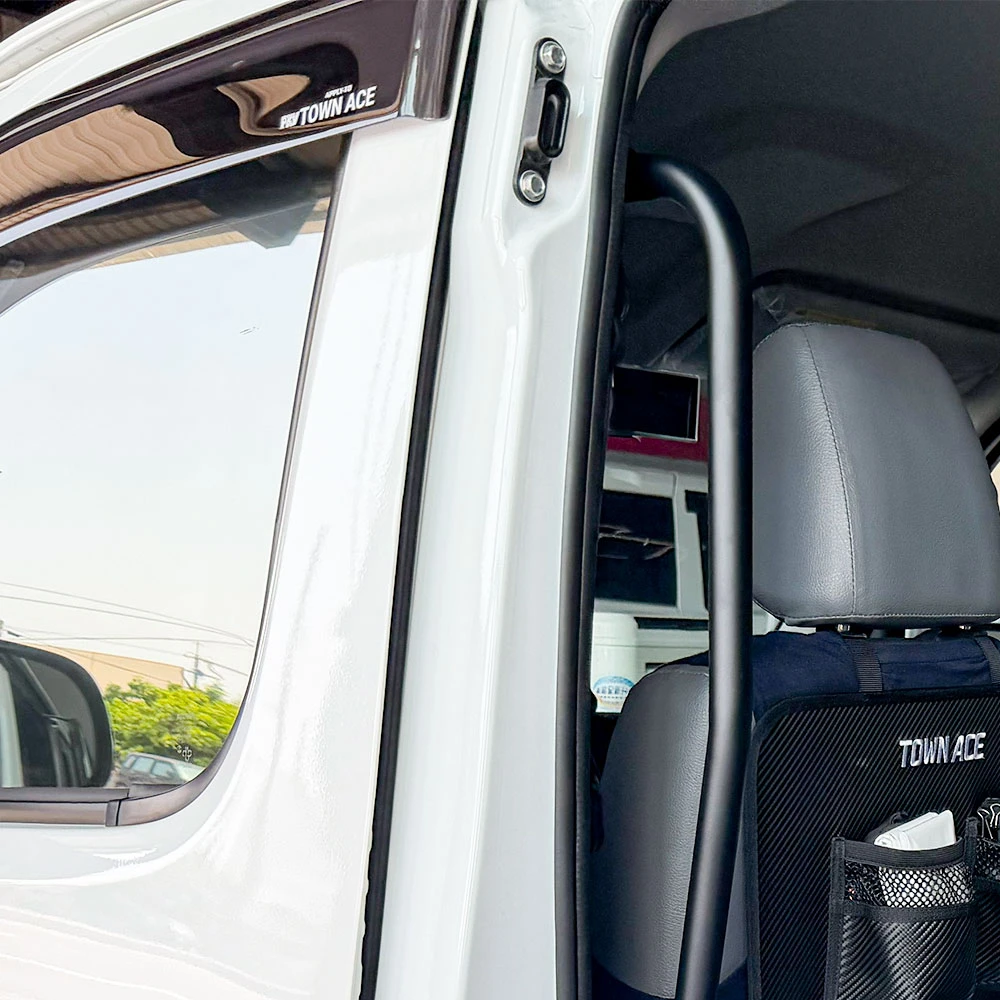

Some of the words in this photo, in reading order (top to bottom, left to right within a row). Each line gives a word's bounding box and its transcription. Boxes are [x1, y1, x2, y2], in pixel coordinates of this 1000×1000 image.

[300, 95, 344, 126] TOWN
[344, 85, 377, 113] ACE
[899, 735, 950, 768] TOWN
[950, 732, 986, 763] ACE
